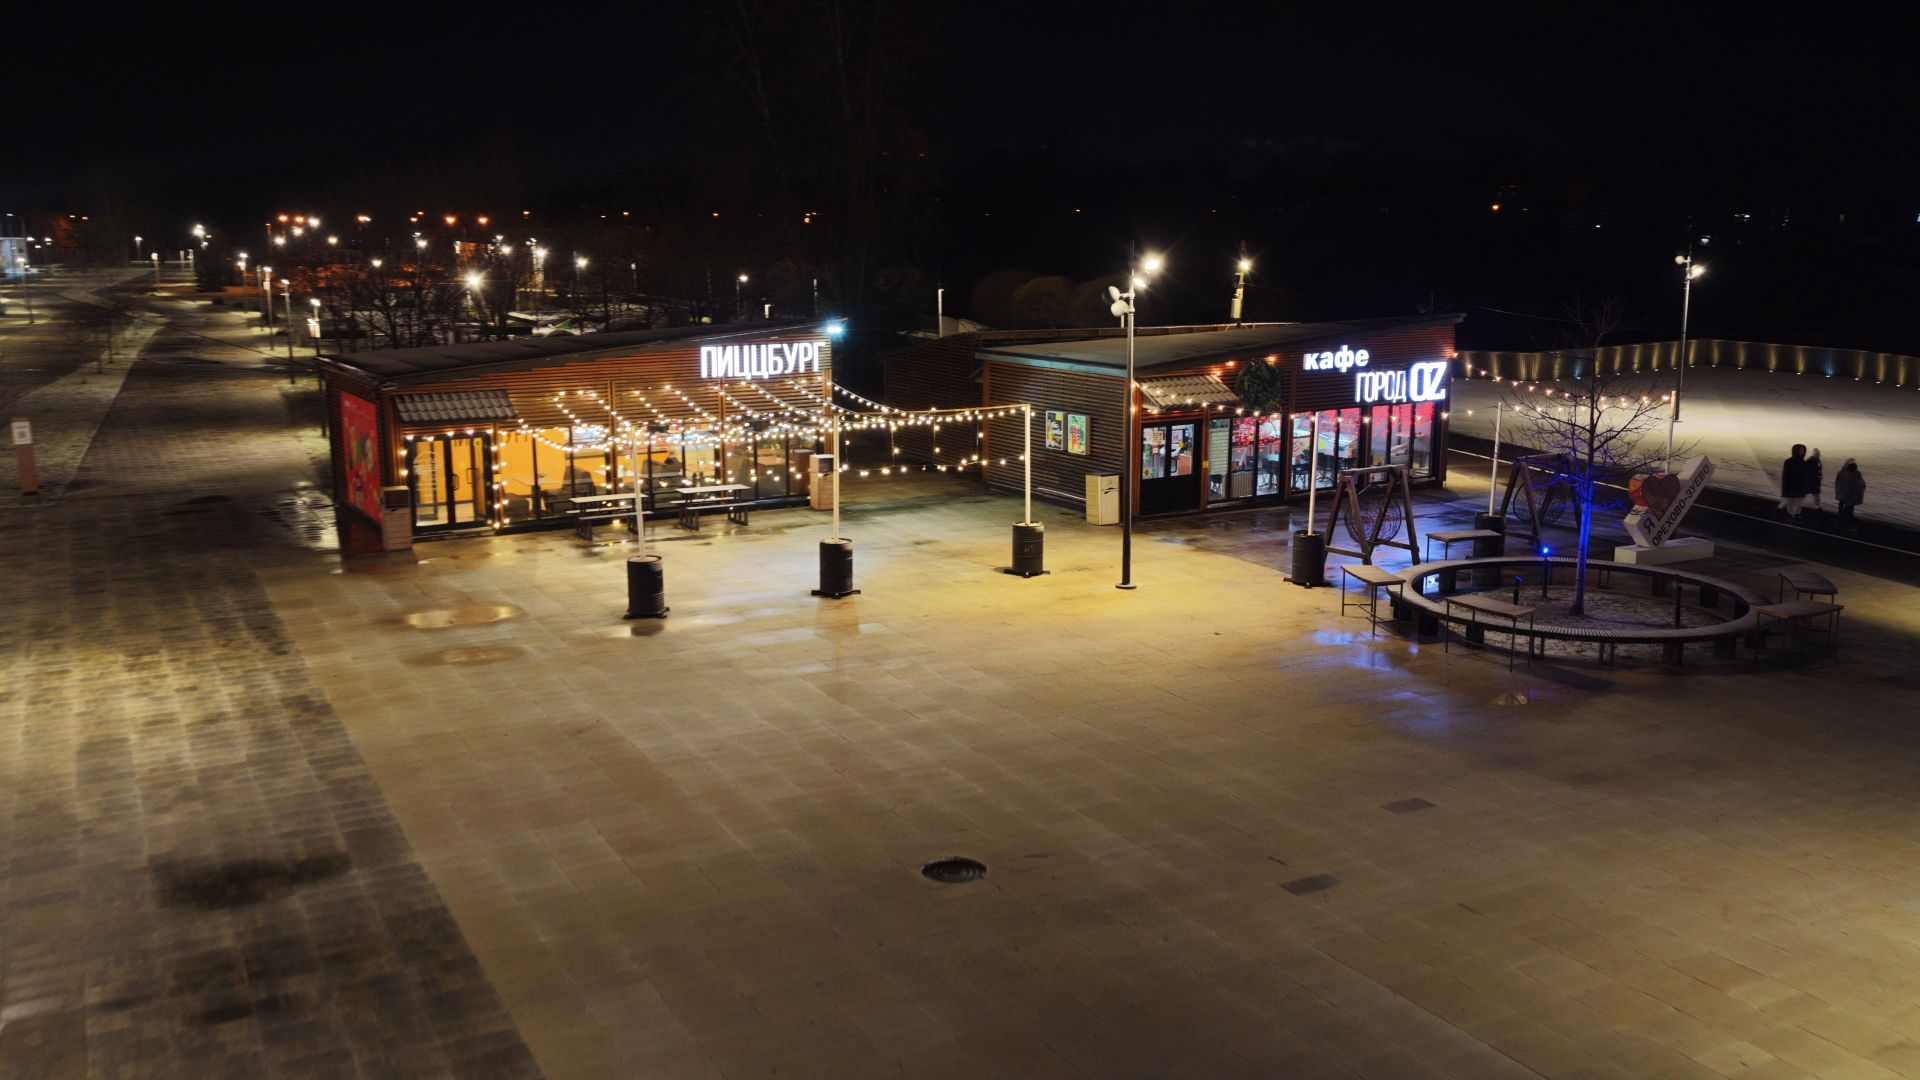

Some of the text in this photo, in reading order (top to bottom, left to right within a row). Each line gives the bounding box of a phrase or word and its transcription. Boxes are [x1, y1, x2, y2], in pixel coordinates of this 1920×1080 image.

[700, 342, 826, 379] ПИЦЦБУРГ
[1303, 345, 1369, 372] кафе
[1356, 361, 1448, 402] ГОРОД OZ
[1652, 464, 1710, 546] ОРЕХОВО-ЗУЕВО
[1643, 517, 1655, 535] Я
